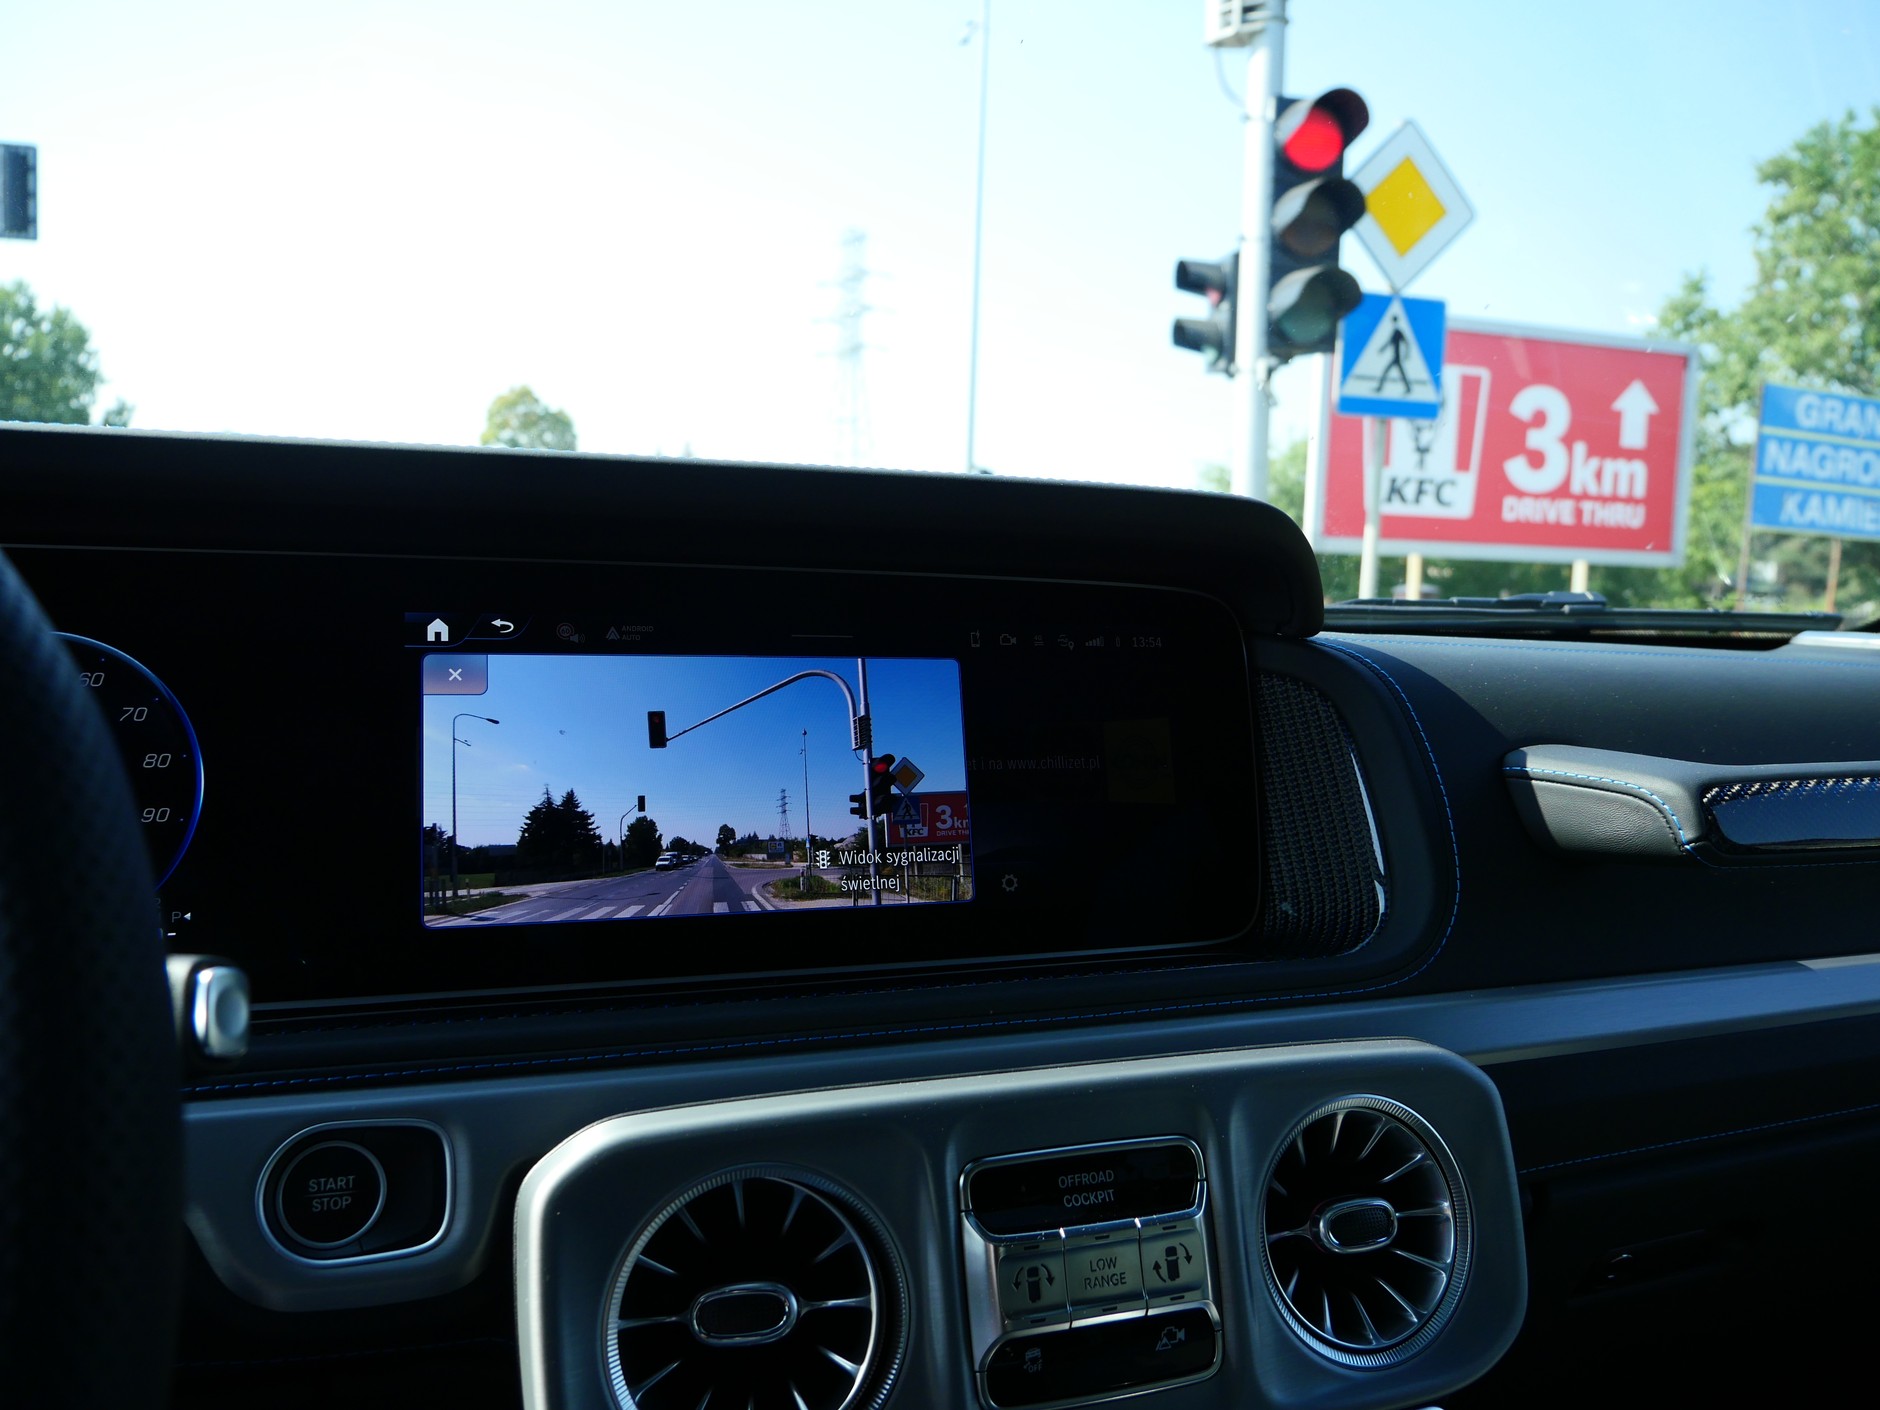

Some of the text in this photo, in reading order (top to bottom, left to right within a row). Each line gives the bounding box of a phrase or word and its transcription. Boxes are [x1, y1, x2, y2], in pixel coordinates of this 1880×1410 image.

[1385, 477, 1456, 508] KFC
[1502, 494, 1646, 530] DRIVE THRU
[1132, 636, 1162, 648] 13:54
[80, 672, 105, 687] 60
[120, 707, 148, 722] 70
[142, 753, 171, 768] 80
[141, 808, 170, 823] 90
[839, 847, 960, 867] Widok sygnalizacji
[841, 874, 900, 892] świetlnej
[171, 911, 182, 923] P
[308, 1175, 356, 1192] START
[1058, 1169, 1115, 1189] OFFROAD
[312, 1196, 352, 1212] STOP
[1063, 1189, 1115, 1208] COCKPIT
[1090, 1256, 1118, 1273] LOW
[1084, 1272, 1128, 1290] RANGE
